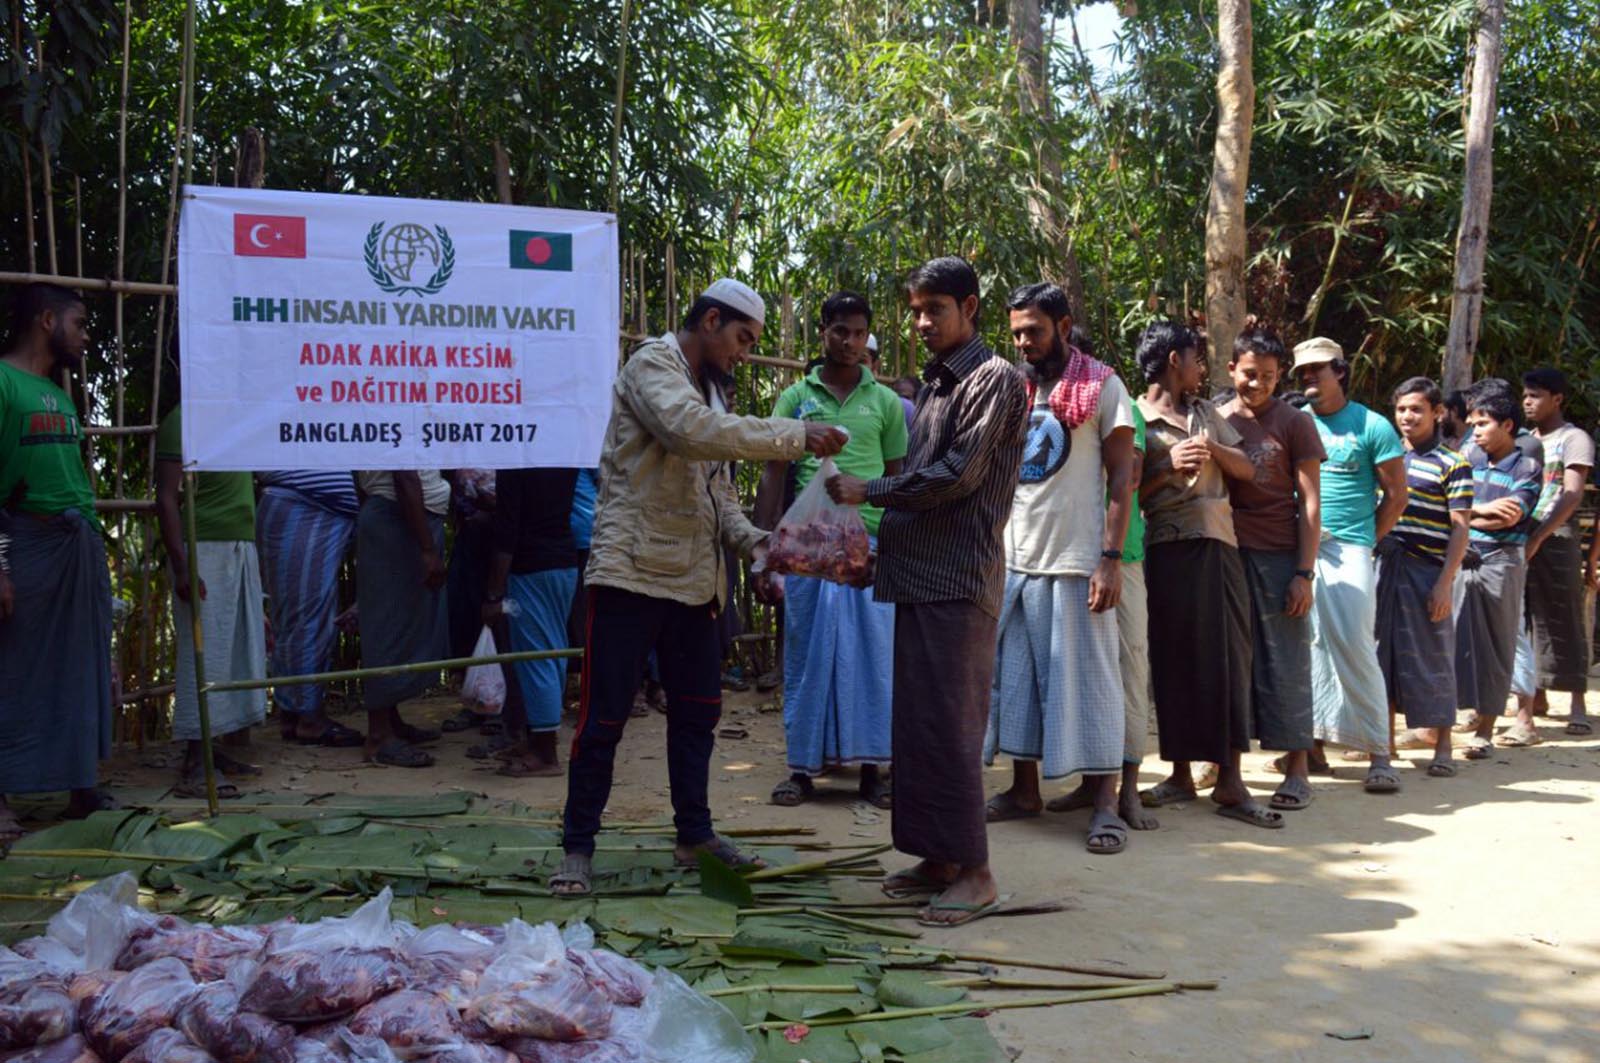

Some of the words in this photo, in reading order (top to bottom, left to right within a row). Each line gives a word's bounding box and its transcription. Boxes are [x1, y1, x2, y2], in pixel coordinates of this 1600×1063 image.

[393, 302, 497, 329] YARDIM
[502, 306, 575, 332] VAKFI
[299, 343, 362, 366] ADAK
[369, 341, 438, 368] AKİKA
[445, 342, 513, 369] KESİM
[296, 386, 323, 402] ve
[331, 376, 427, 404] DAĞITIM
[435, 379, 522, 405] PROJESİ
[279, 422, 402, 448] BANGLADEŞ
[421, 423, 485, 448] ŞUBAT
[490, 423, 537, 443] 2017
